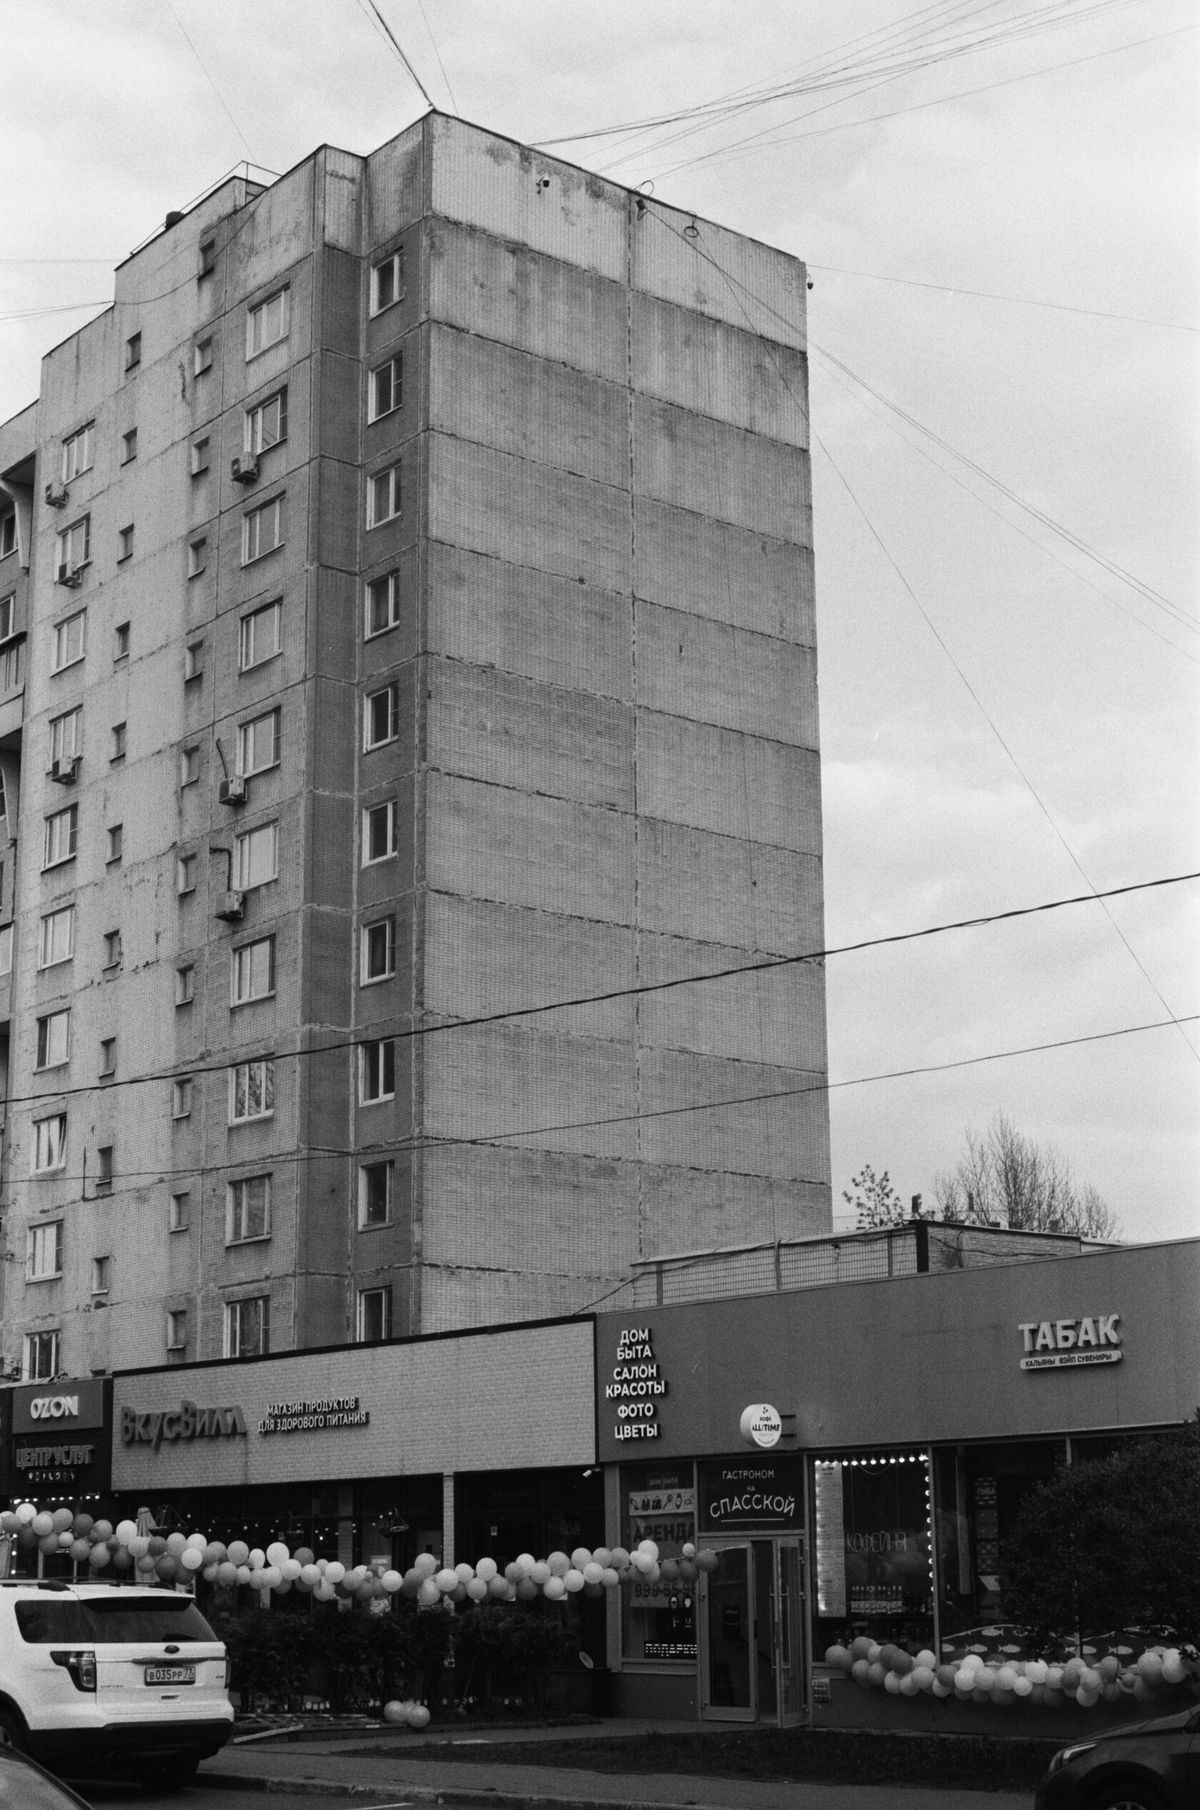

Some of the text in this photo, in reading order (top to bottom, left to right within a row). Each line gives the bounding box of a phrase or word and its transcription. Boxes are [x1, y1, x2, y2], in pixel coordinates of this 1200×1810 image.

[620, 1328, 649, 1346] ДОМ
[1018, 1314, 1121, 1352] ТАБАК
[616, 1344, 652, 1360] БЫТА
[1077, 1353, 1112, 1363] СУВЕНИРЫ
[613, 1364, 657, 1381] САЛОН
[605, 1380, 665, 1398] КРАСОТЫ
[30, 1395, 79, 1419] OZON
[266, 1397, 356, 1416] МАГАЗИН ПРОДУКТОВ
[617, 1403, 654, 1418] ФОТО
[258, 1411, 366, 1433] ДЛЯ ЗДОРОВОГО ПИТАНИЯ
[614, 1423, 657, 1440] ЦВЕТЫ
[722, 1469, 775, 1480] ГАСТРОНОМ
[710, 1494, 796, 1518] СПАССКОЙ
[846, 1531, 907, 1553] КОФЕЙНЯ
